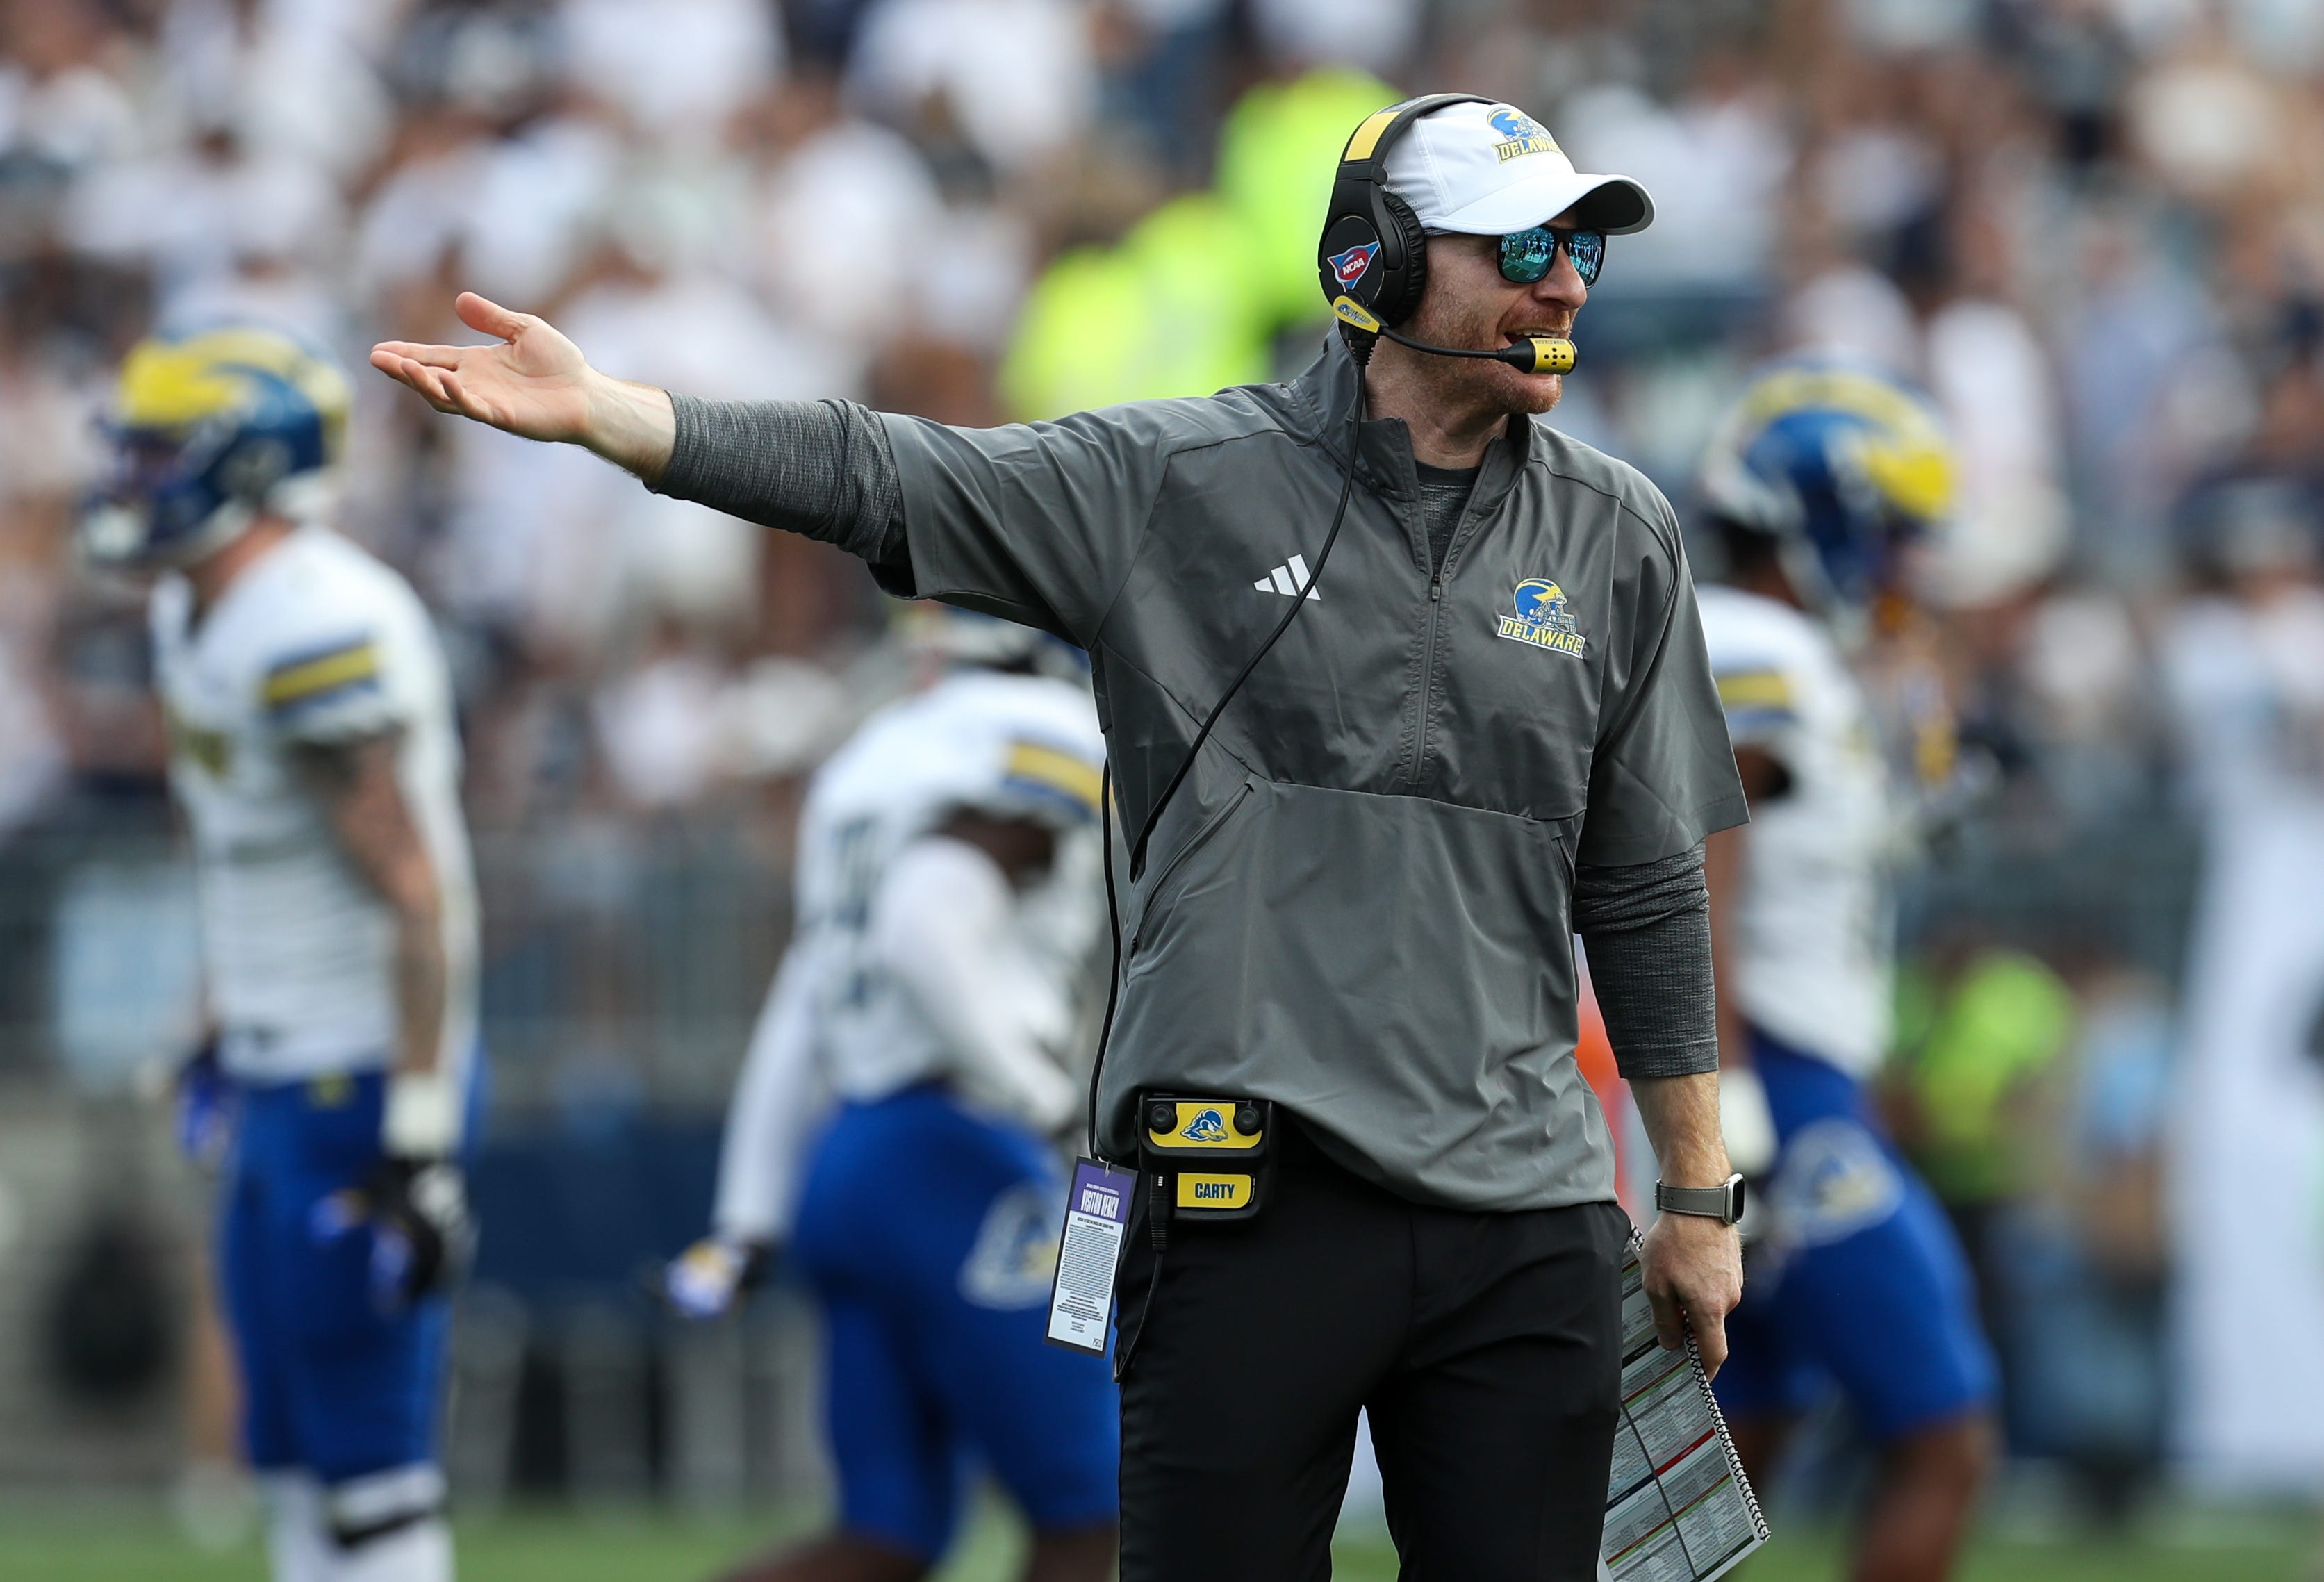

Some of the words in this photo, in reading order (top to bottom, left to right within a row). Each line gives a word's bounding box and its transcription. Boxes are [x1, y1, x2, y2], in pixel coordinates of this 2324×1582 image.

[1499, 138, 1560, 160] DELAWA
[1342, 258, 1365, 275] NCAA
[1501, 619, 1583, 654] DELAWARE
[1195, 1183, 1235, 1199] CARTY
[1081, 1189, 1103, 1215] VISITOR
[1101, 1194, 1119, 1219] BENCH
